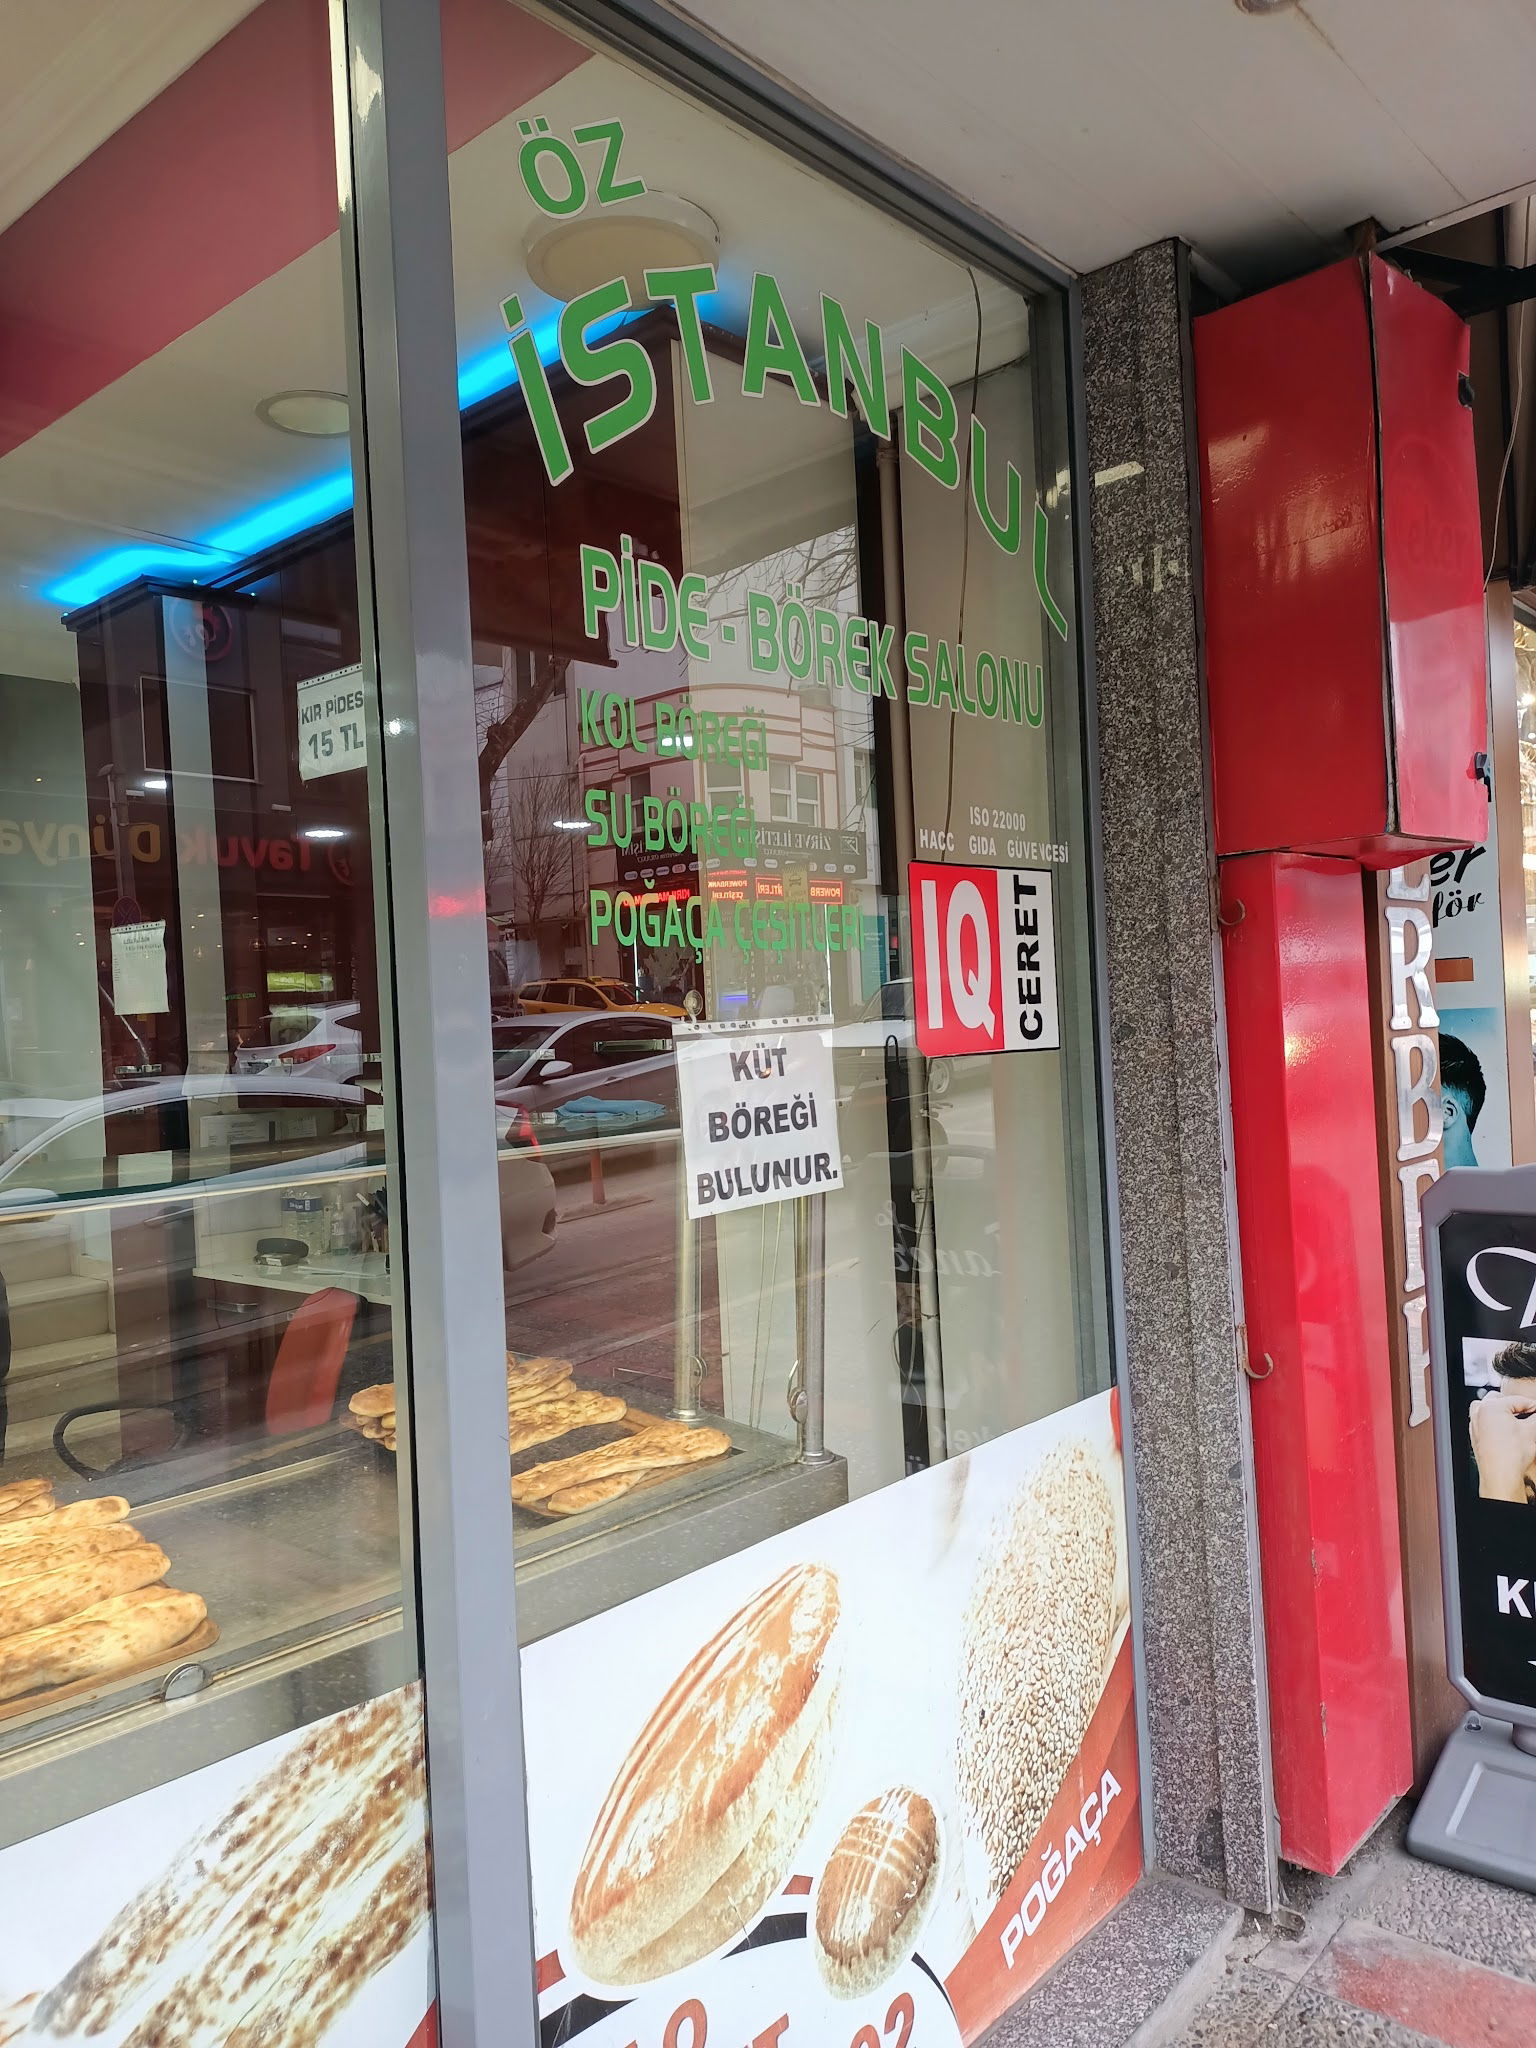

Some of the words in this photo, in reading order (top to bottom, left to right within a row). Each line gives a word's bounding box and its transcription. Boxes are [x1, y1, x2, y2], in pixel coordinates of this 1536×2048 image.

[518, 116, 647, 219] ÖZ
[499, 263, 1068, 642] İSTANBUL
[580, 533, 711, 661] PİDE
[747, 583, 898, 700] BÖREK
[905, 631, 1044, 729] SALONU
[302, 703, 322, 725] KIR
[326, 690, 364, 719] PİDES
[579, 687, 648, 753] KOL
[655, 694, 767, 771] BÖREĞİ
[308, 730, 334, 760] 15
[339, 723, 364, 751] TL
[584, 788, 632, 849] SU
[643, 785, 758, 858] BÖREĞİ
[919, 828, 955, 851] HACC
[969, 835, 997, 856] GIDA
[969, 806, 990, 826] ISO
[992, 810, 1026, 832] 22000
[1429, 846, 1486, 887] er
[589, 879, 726, 964] POĞAÇA
[1431, 890, 1485, 928] för
[920, 879, 996, 1040] IQ
[730, 1042, 787, 1082] KÜT
[708, 1092, 818, 1143] BÖREĞİ
[697, 1152, 838, 1205] BULUNUR.
[1000, 1768, 1122, 1970] POĞAÇA
